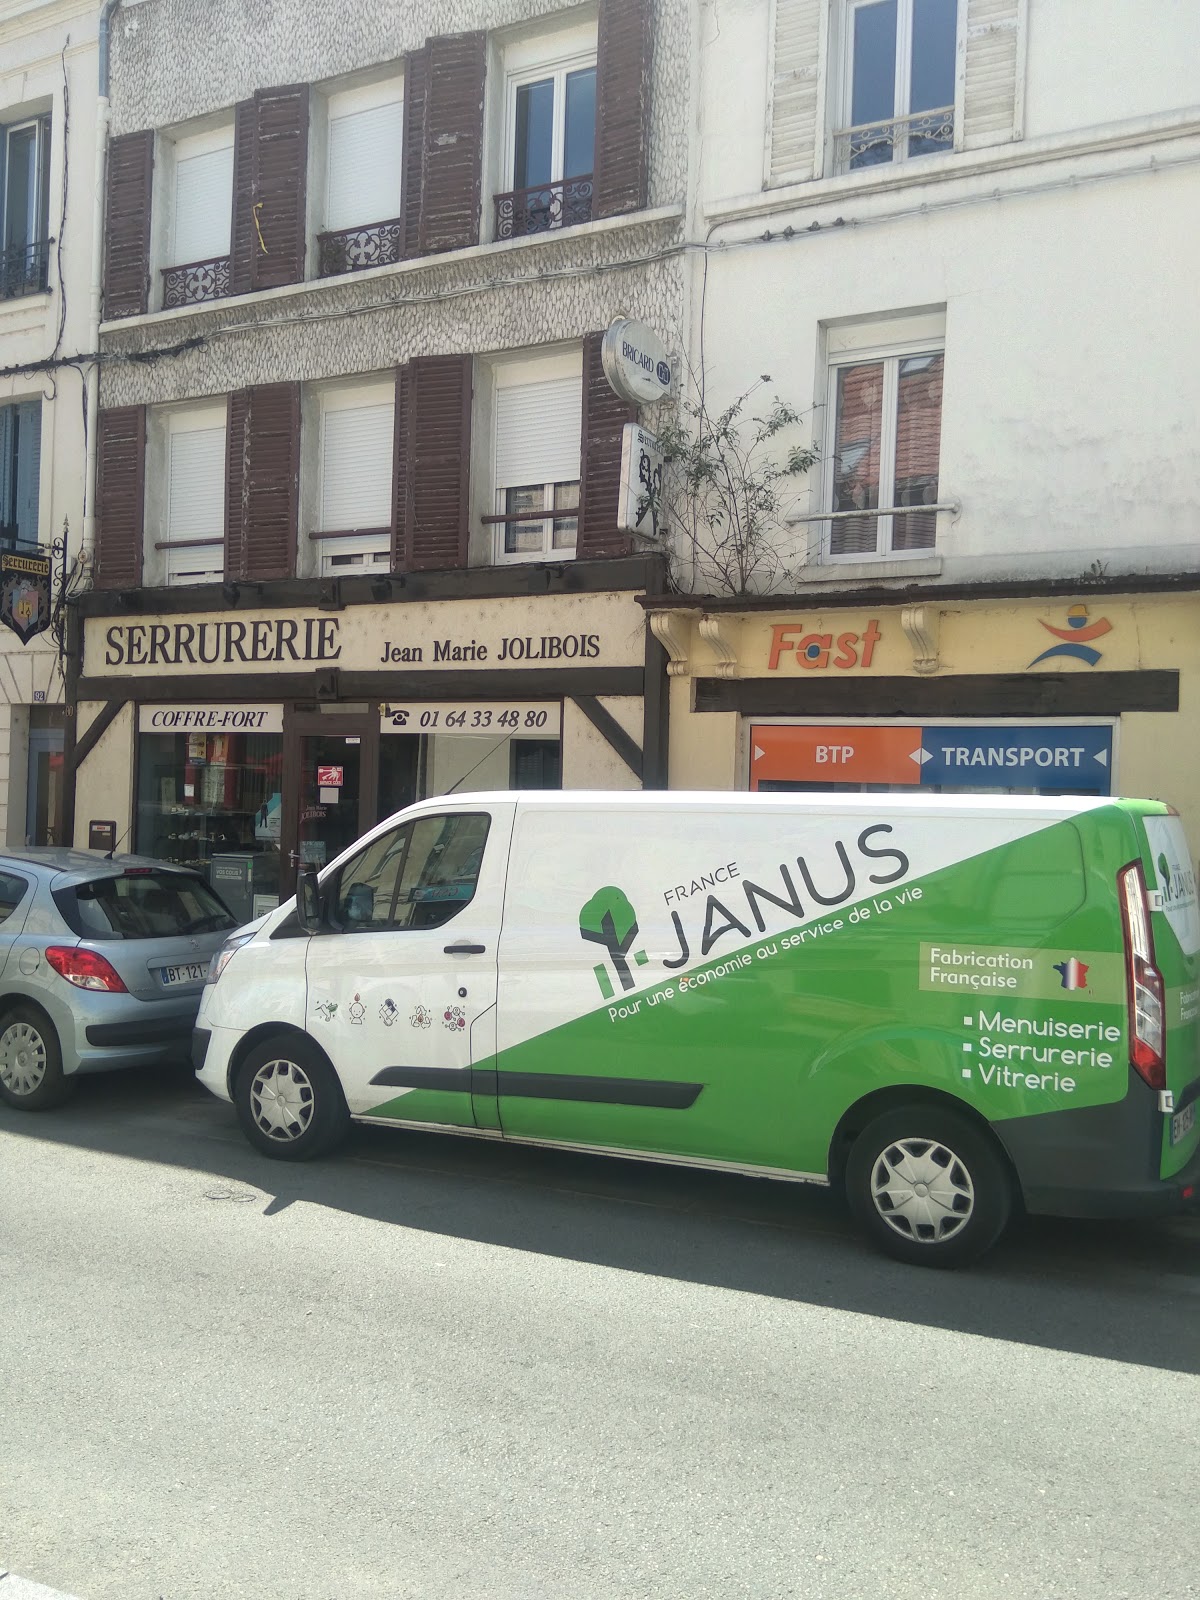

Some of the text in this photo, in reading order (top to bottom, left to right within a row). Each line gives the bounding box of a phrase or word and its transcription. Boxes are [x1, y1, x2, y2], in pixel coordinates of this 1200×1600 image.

[623, 341, 654, 372] BRICARD
[105, 618, 342, 665] SERRURERIE
[381, 634, 600, 662] Jean Marie JOLIBOIS
[768, 619, 882, 670] Fast
[35, 691, 44, 701] 92
[152, 711, 268, 727] COFFRE-FORT
[420, 710, 548, 727] 01 64 33 48 80
[815, 746, 854, 764] BTP
[941, 747, 1085, 767] TRANSPORT
[663, 862, 741, 906] FRANCE
[663, 823, 909, 969] JANUS
[608, 887, 923, 1022] Pour une économie au service de la vie
[930, 948, 1033, 970] Fabrication
[930, 967, 1017, 990] Française
[979, 1010, 1121, 1042] Menuiserie
[978, 1037, 1113, 1068] Serrurerie
[978, 1063, 1076, 1092] Vitrerie
